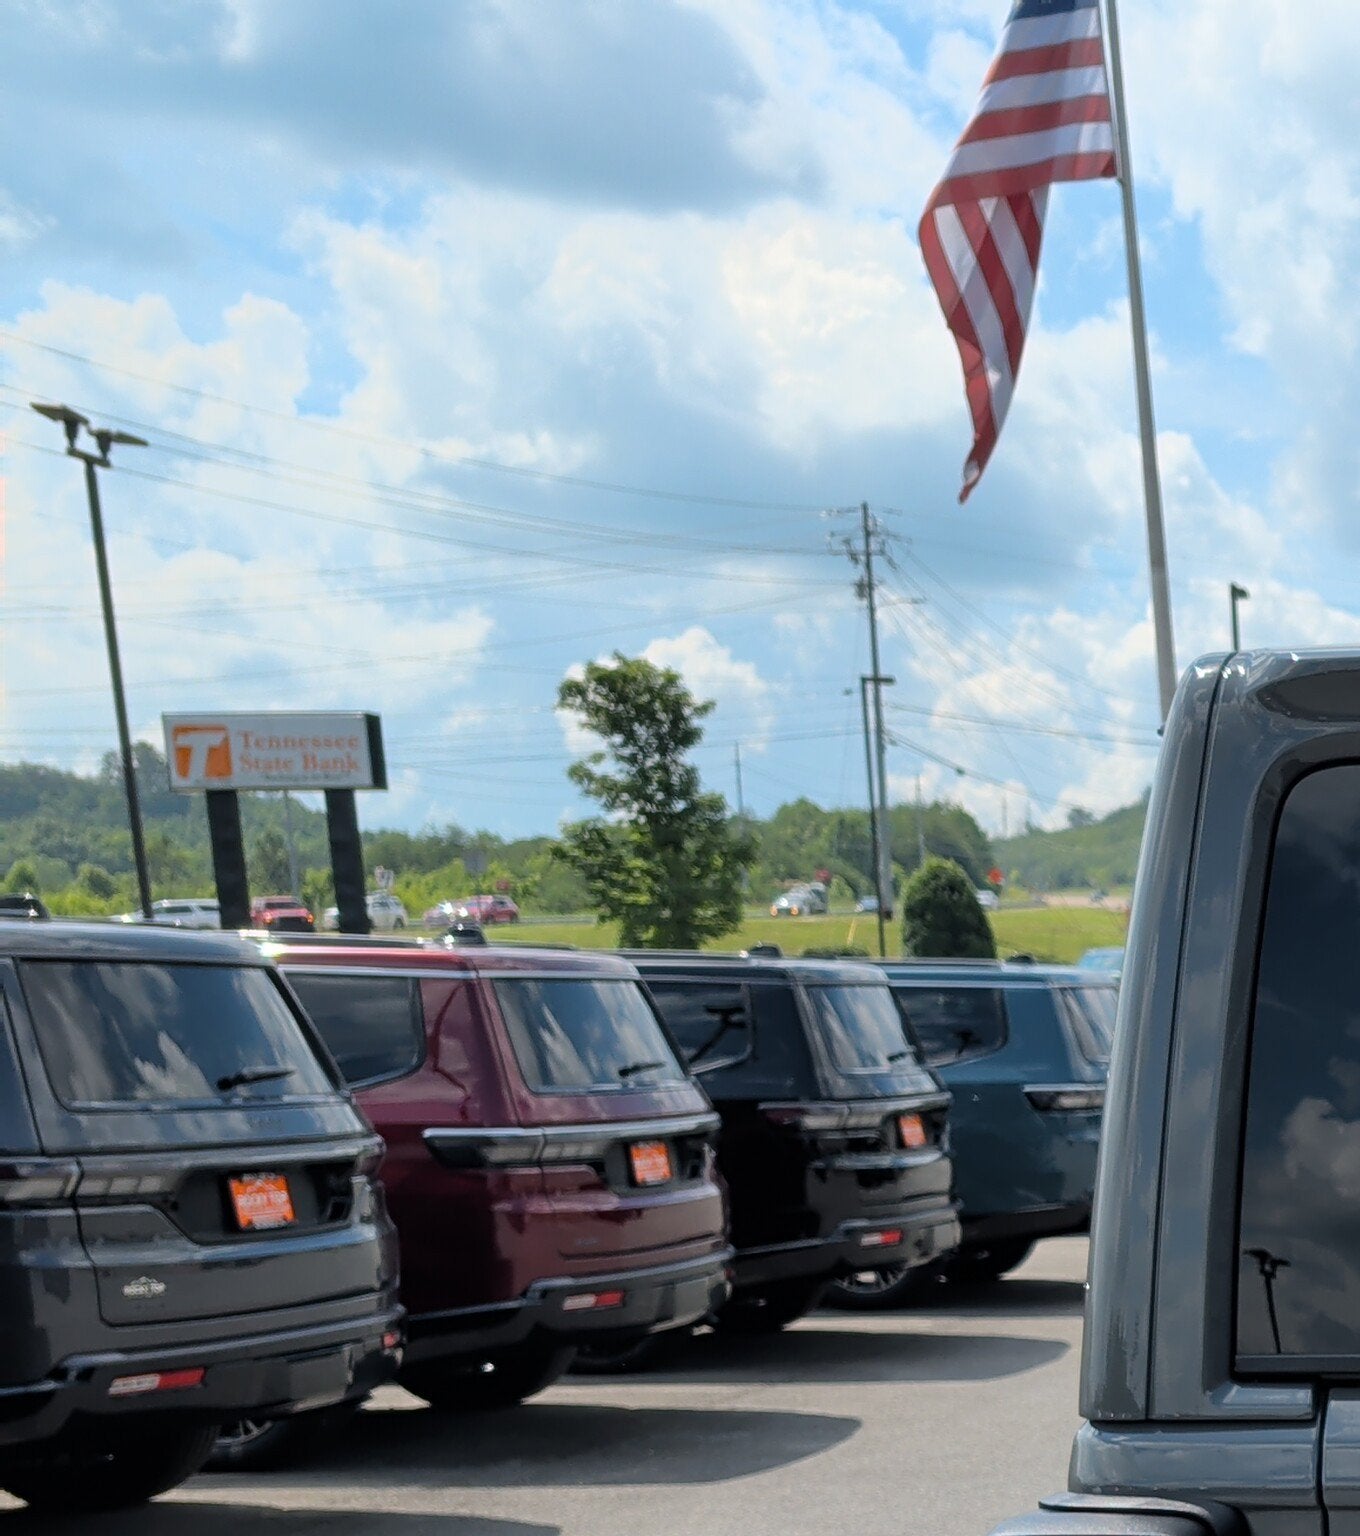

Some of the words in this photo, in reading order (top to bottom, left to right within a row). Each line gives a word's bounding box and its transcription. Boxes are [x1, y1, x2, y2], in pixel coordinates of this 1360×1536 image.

[239, 730, 360, 749] Tennessee
[240, 755, 293, 773] State
[303, 753, 360, 772] Bank
